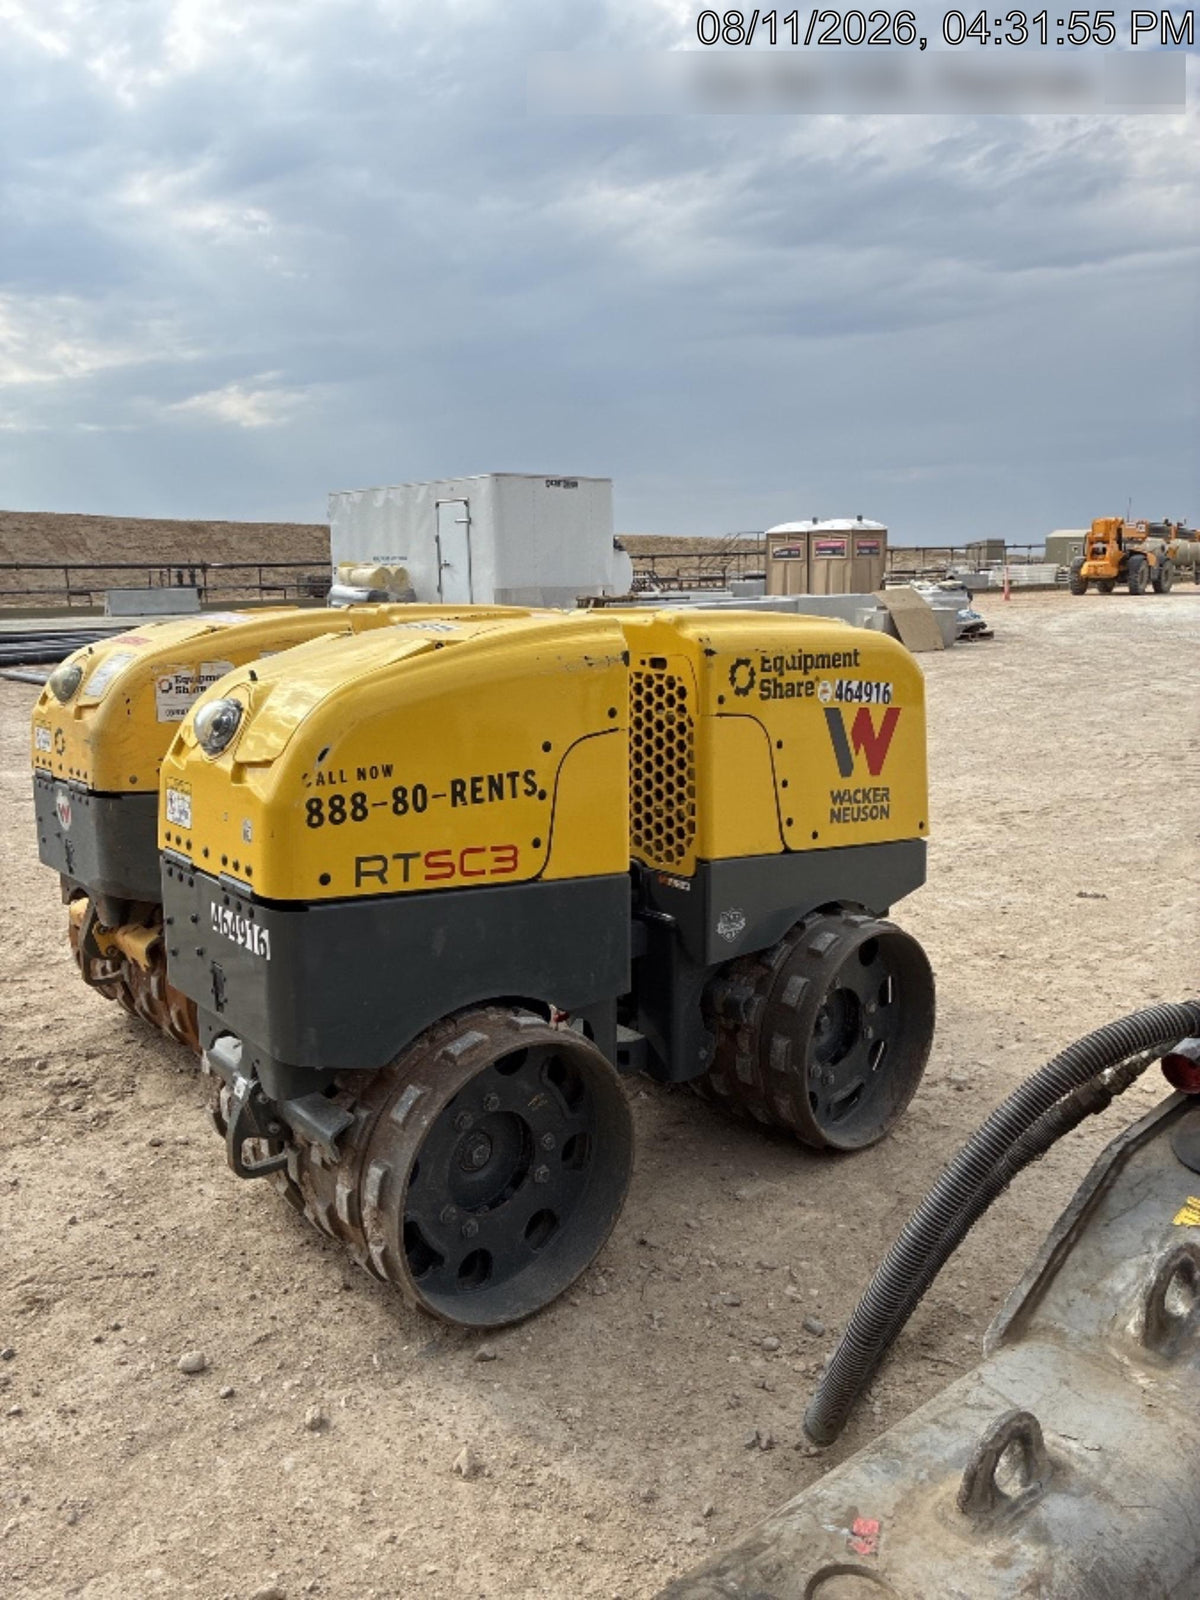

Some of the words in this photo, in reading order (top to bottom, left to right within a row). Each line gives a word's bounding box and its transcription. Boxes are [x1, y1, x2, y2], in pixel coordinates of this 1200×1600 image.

[760, 648, 860, 676] Equipment
[759, 677, 815, 700] Share
[835, 679, 892, 704] 464916
[356, 764, 394, 781] NOW
[829, 787, 891, 805] WACKER
[829, 804, 890, 824] NEUSON
[354, 844, 520, 888] RTSC3
